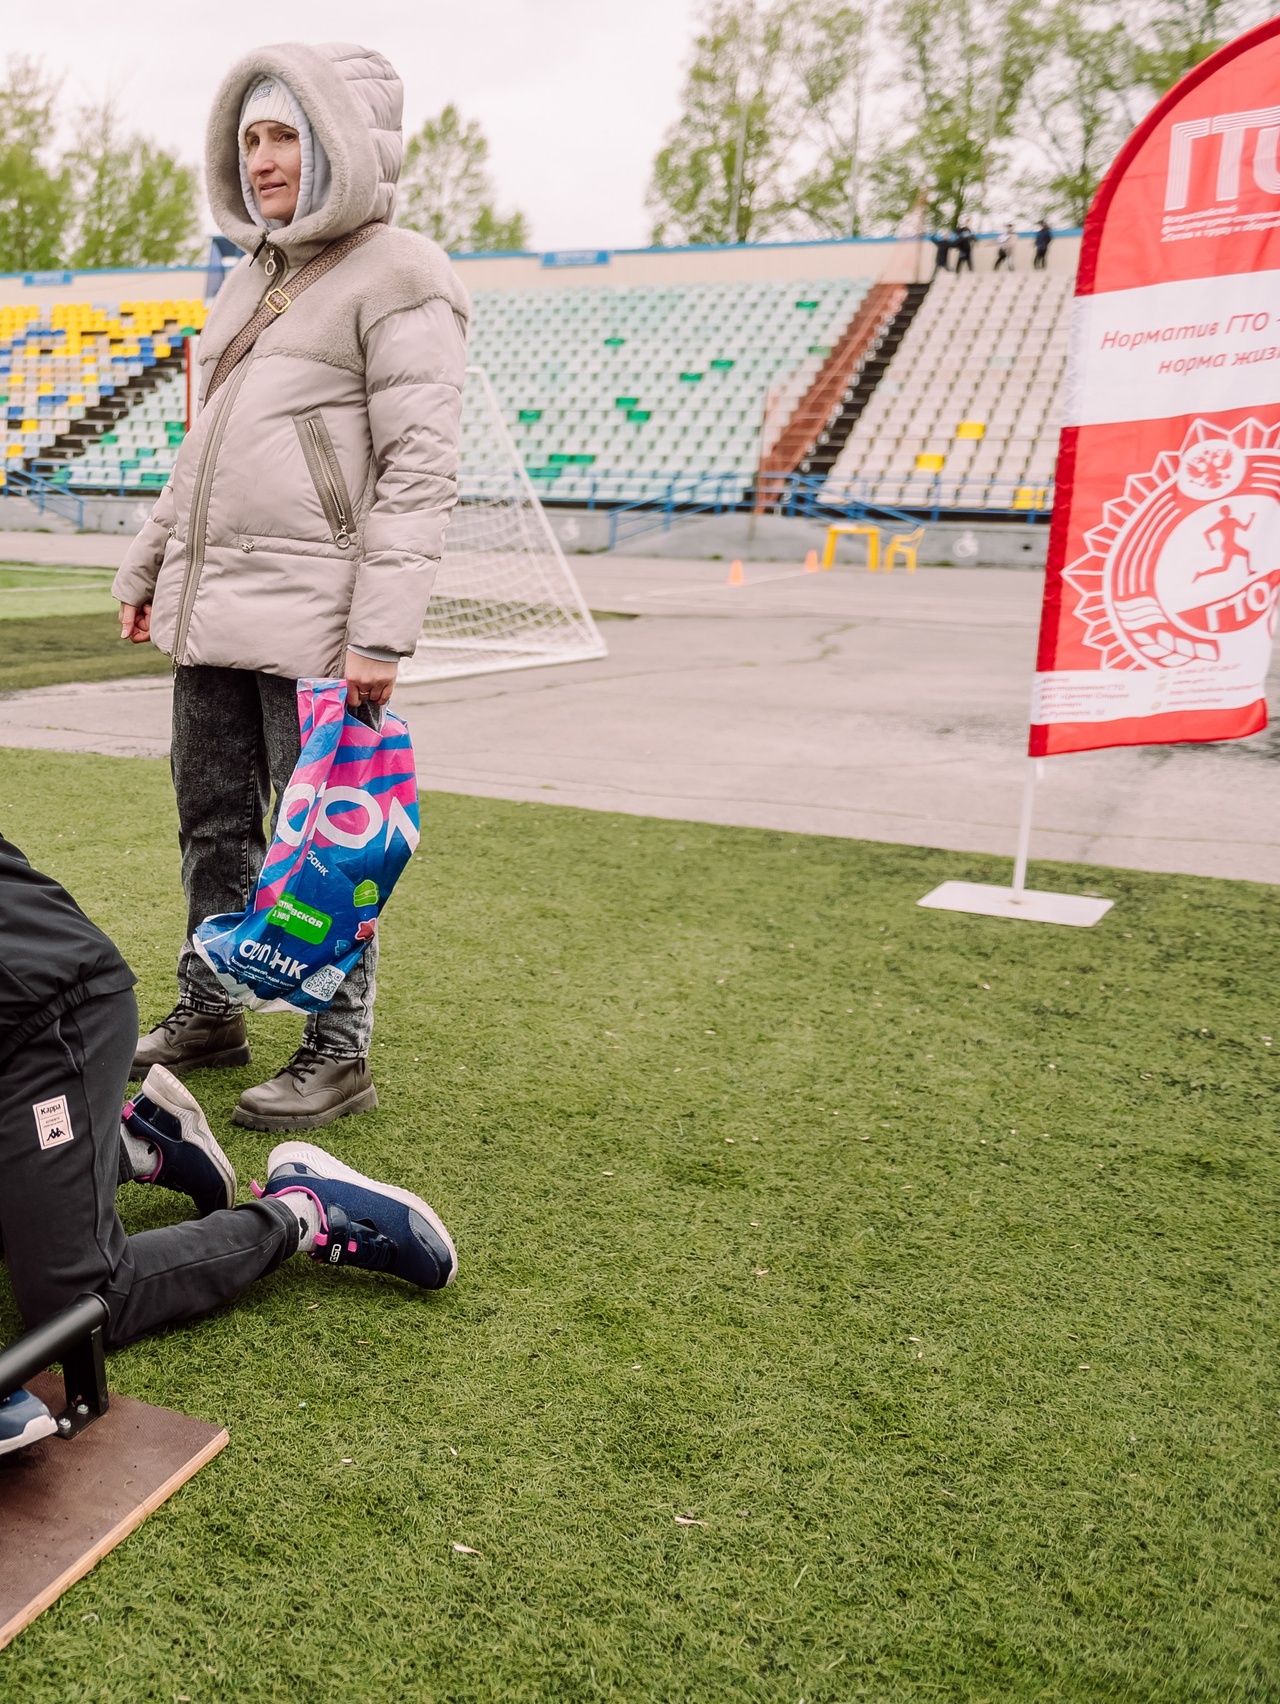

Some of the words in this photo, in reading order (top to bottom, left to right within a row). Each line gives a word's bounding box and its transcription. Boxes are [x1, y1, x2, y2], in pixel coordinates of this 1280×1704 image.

[1100, 322, 1220, 351] Норматив
[1225, 312, 1270, 335] ГТО
[1157, 352, 1227, 376] норма
[1231, 346, 1280, 366] жиз
[1205, 581, 1270, 632] ГТО
[306, 850, 330, 877] банк
[40, 1103, 61, 1115] Kappa
[329, 1243, 342, 1263] GSD
